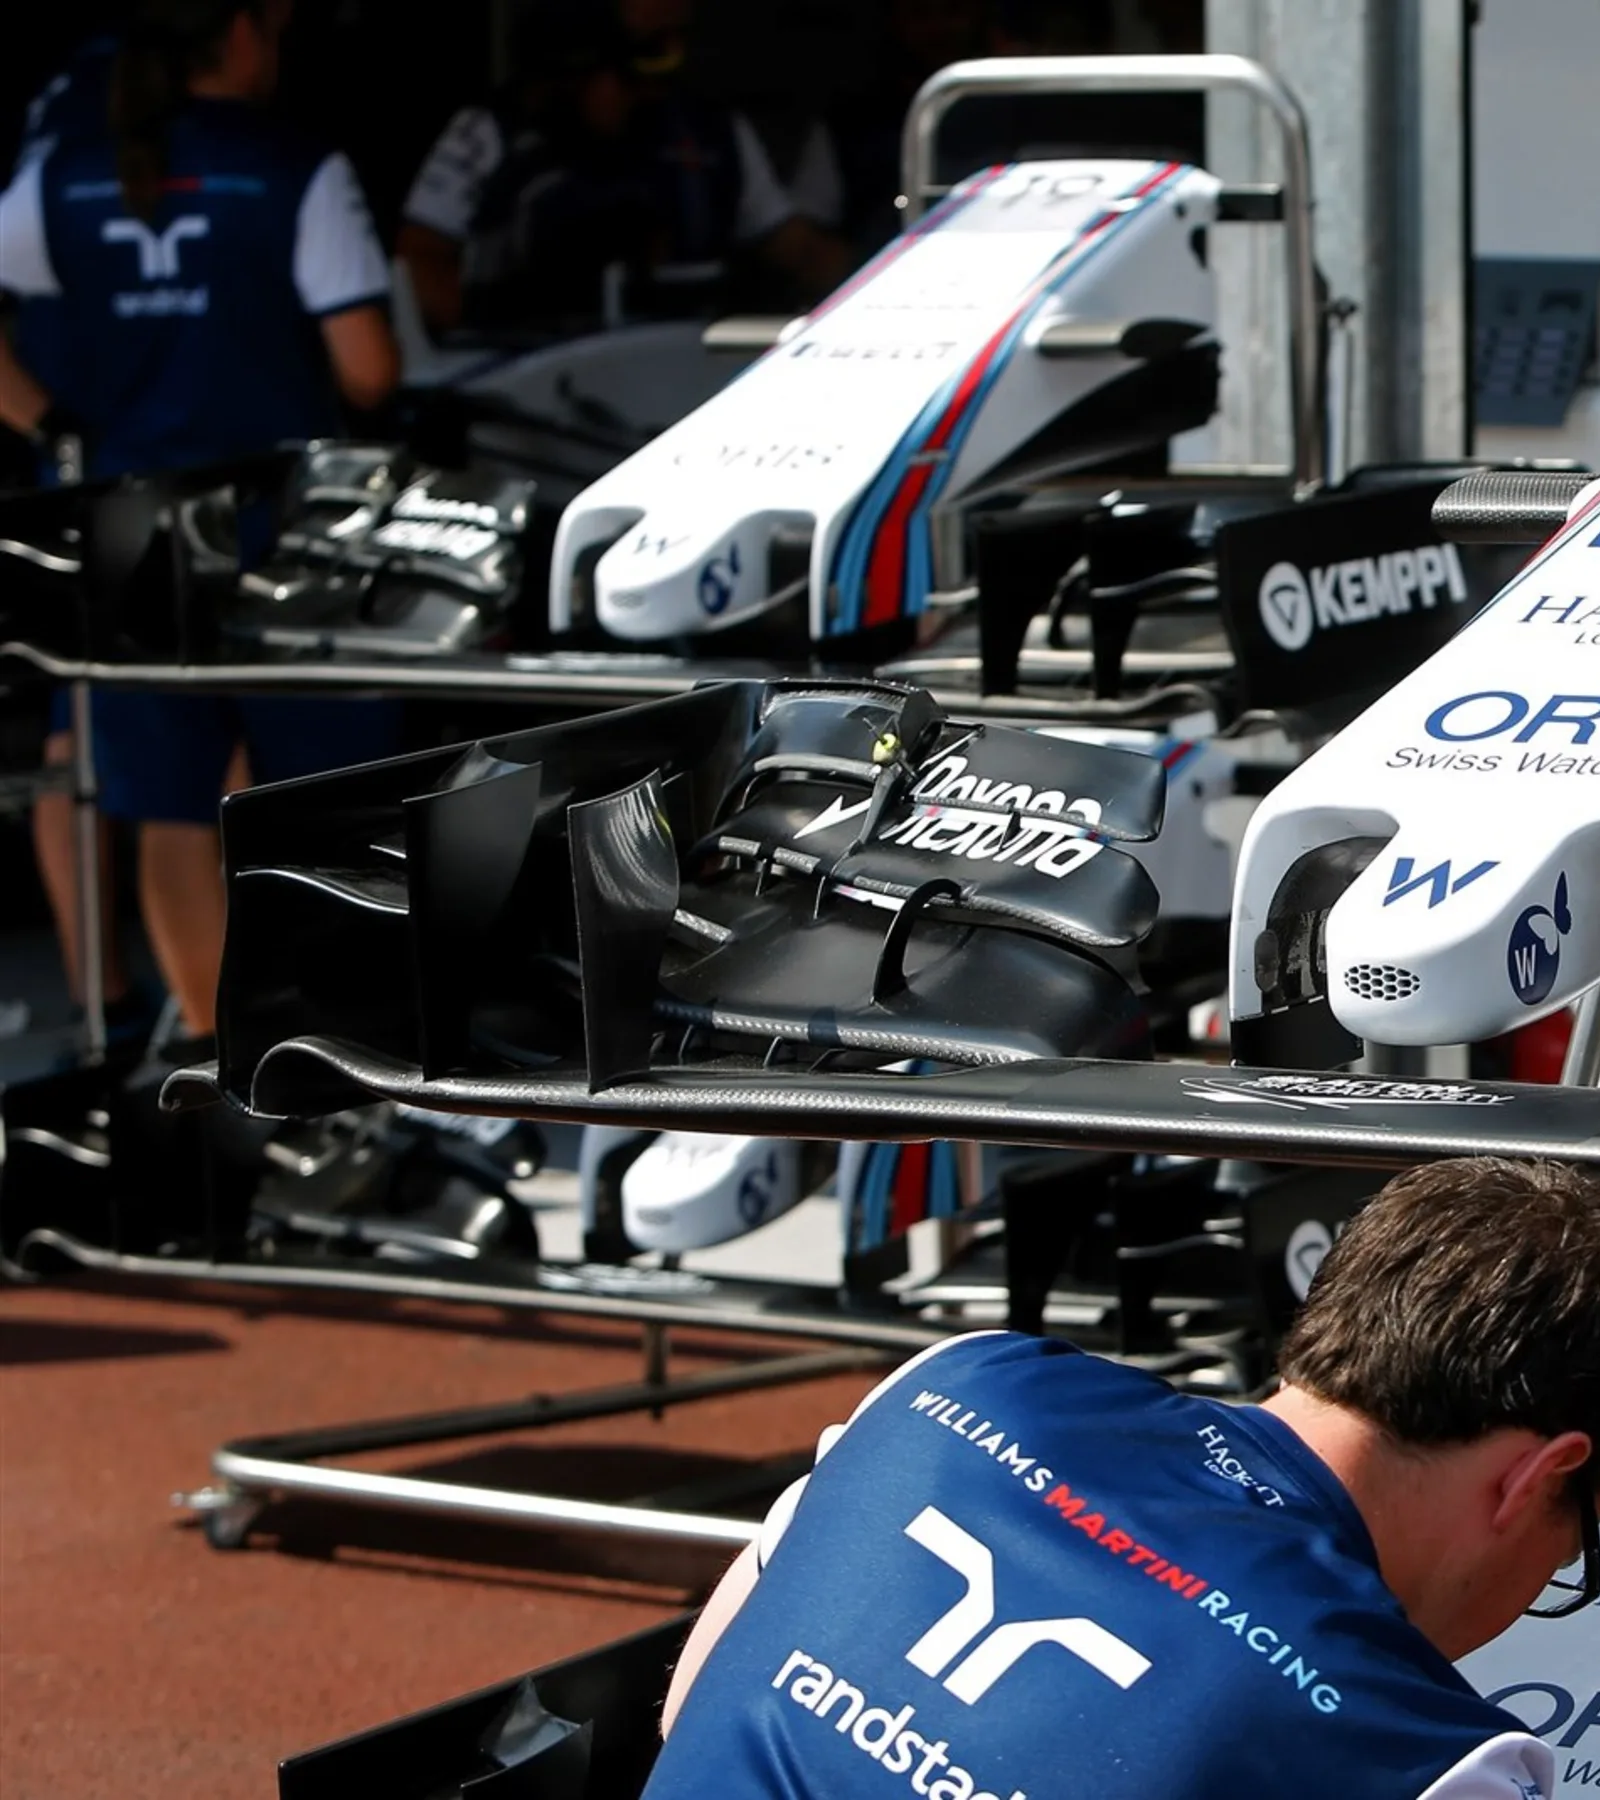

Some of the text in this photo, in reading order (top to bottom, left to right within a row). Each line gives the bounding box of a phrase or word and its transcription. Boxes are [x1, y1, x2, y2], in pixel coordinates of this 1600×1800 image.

[1310, 542, 1467, 629] KEMPPI
[1386, 747, 1503, 773] Swiss
[909, 1390, 1341, 1714] WILLIAMS MARTINI RACING
